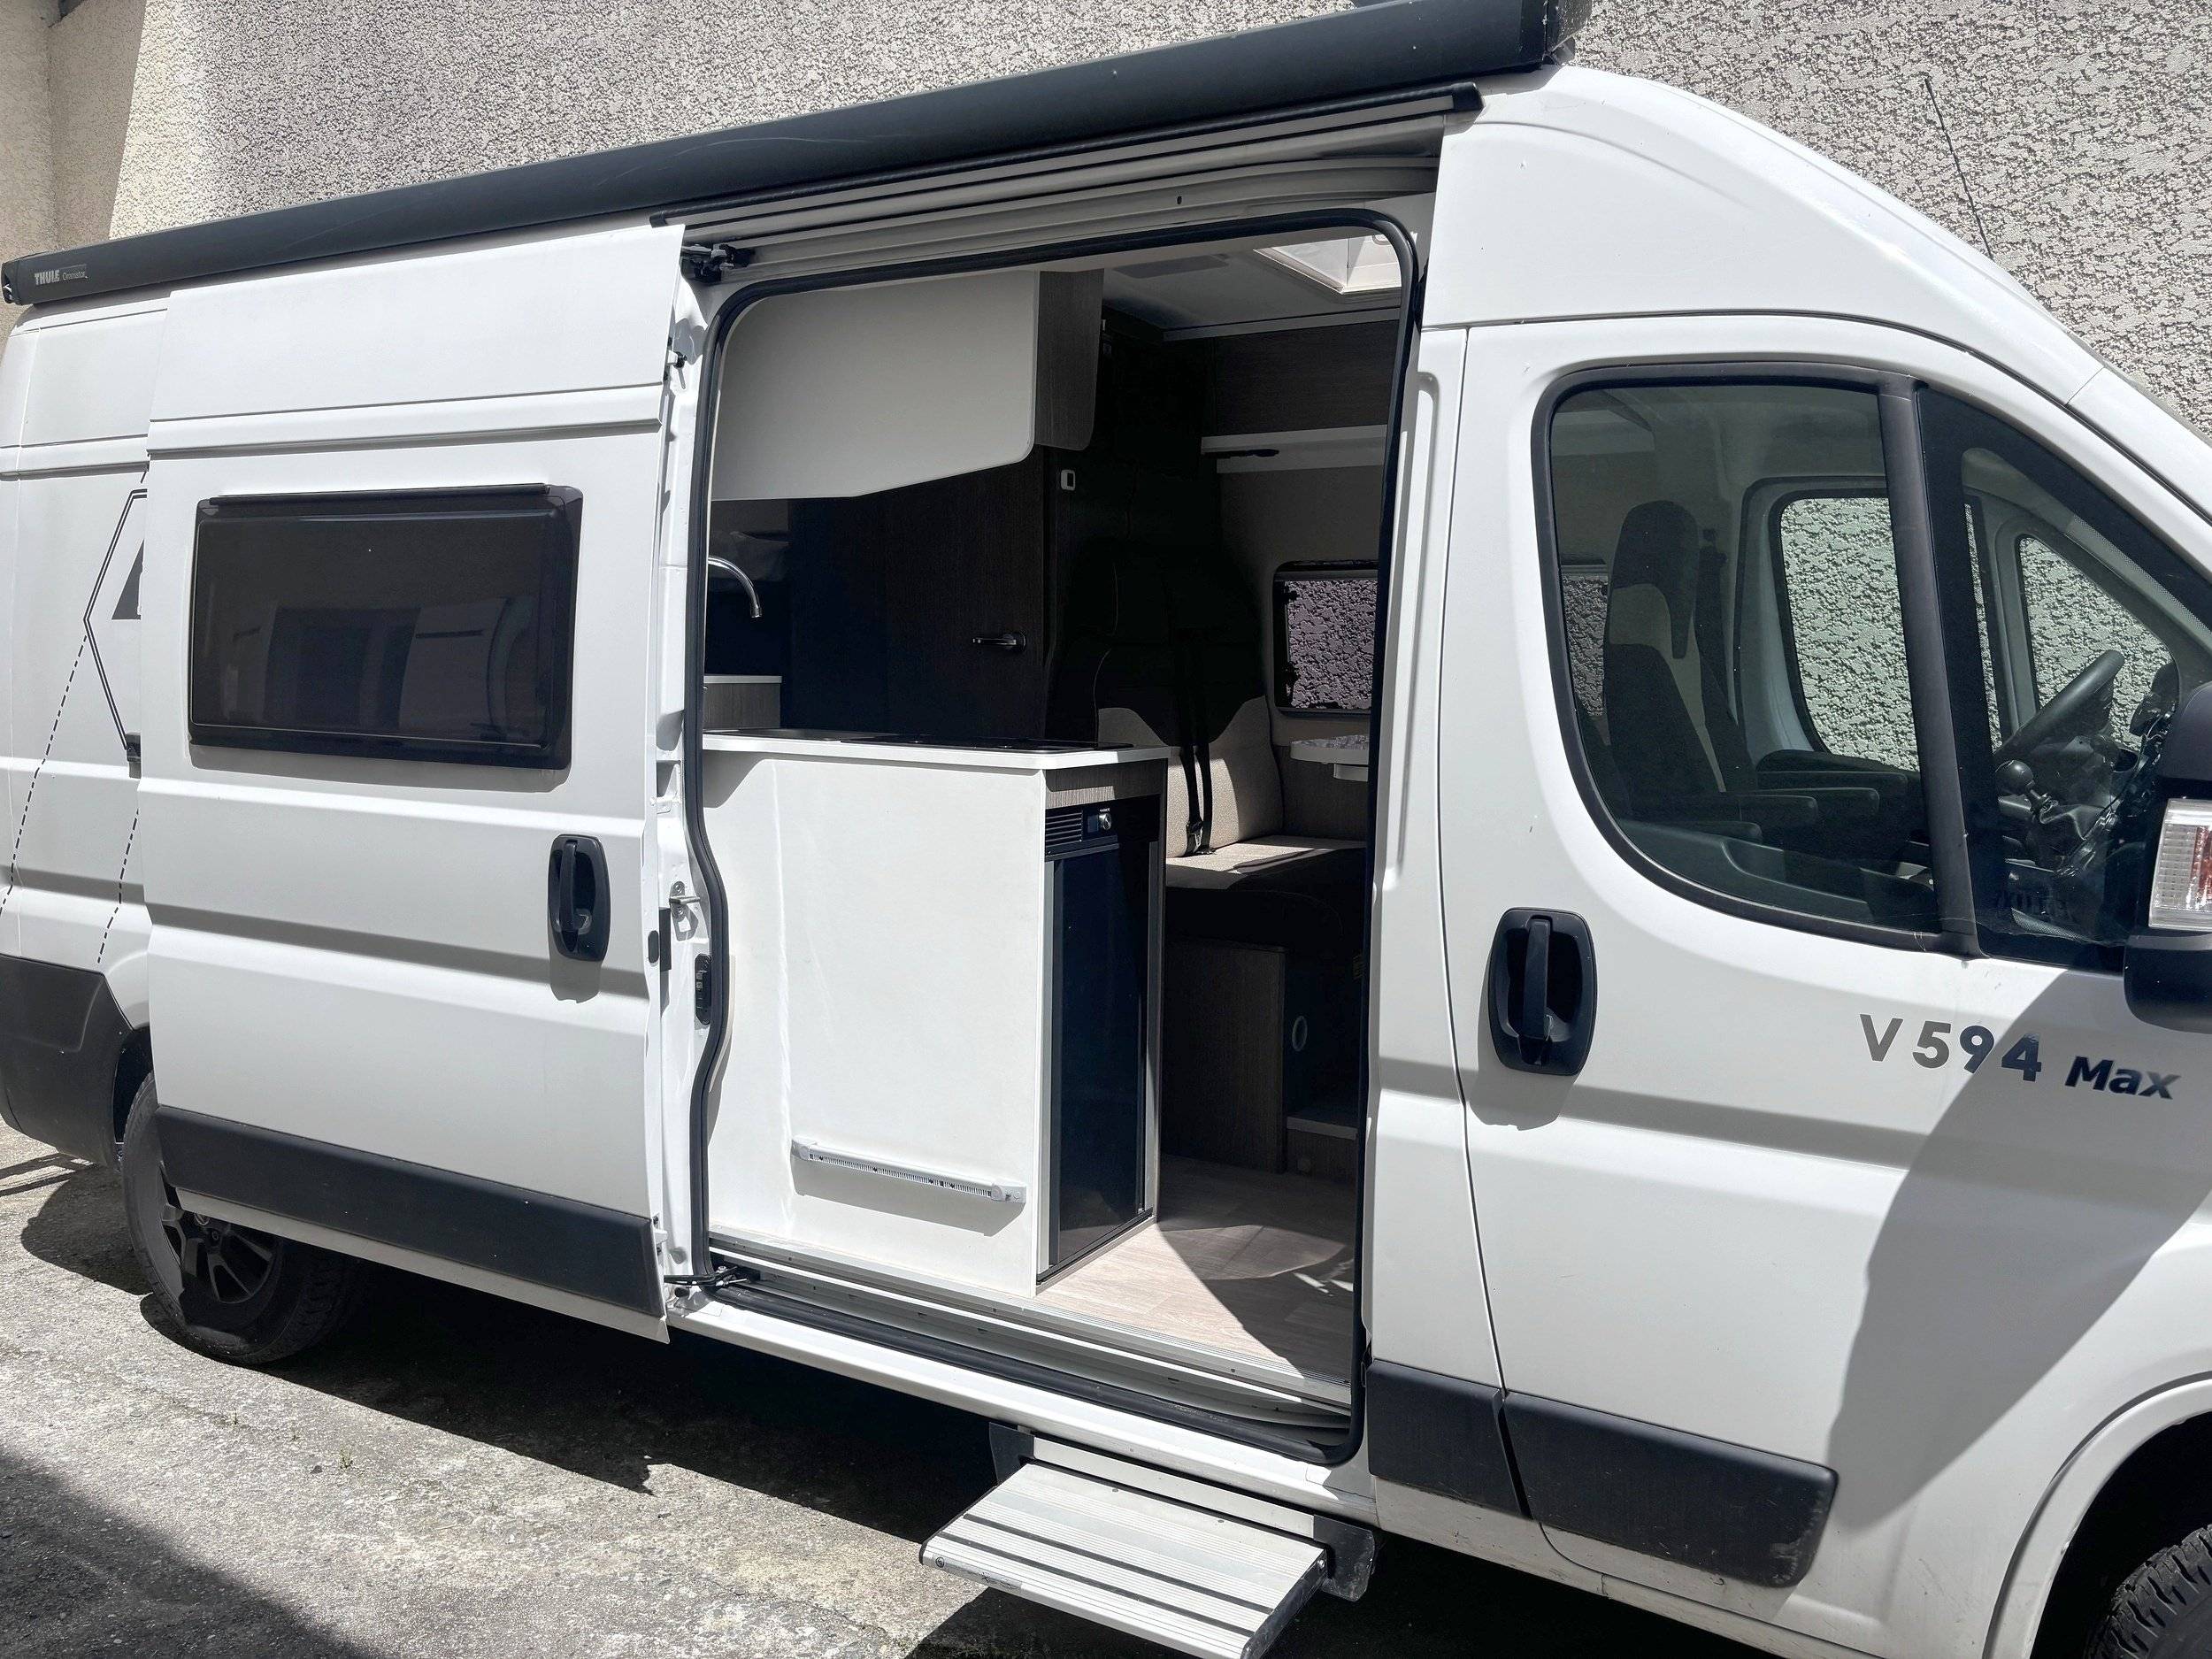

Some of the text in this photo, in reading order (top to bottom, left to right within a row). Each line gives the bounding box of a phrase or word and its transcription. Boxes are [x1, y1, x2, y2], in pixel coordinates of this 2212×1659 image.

[35, 269, 60, 286] THULE
[1859, 1013, 2181, 1099] V 594 Max
